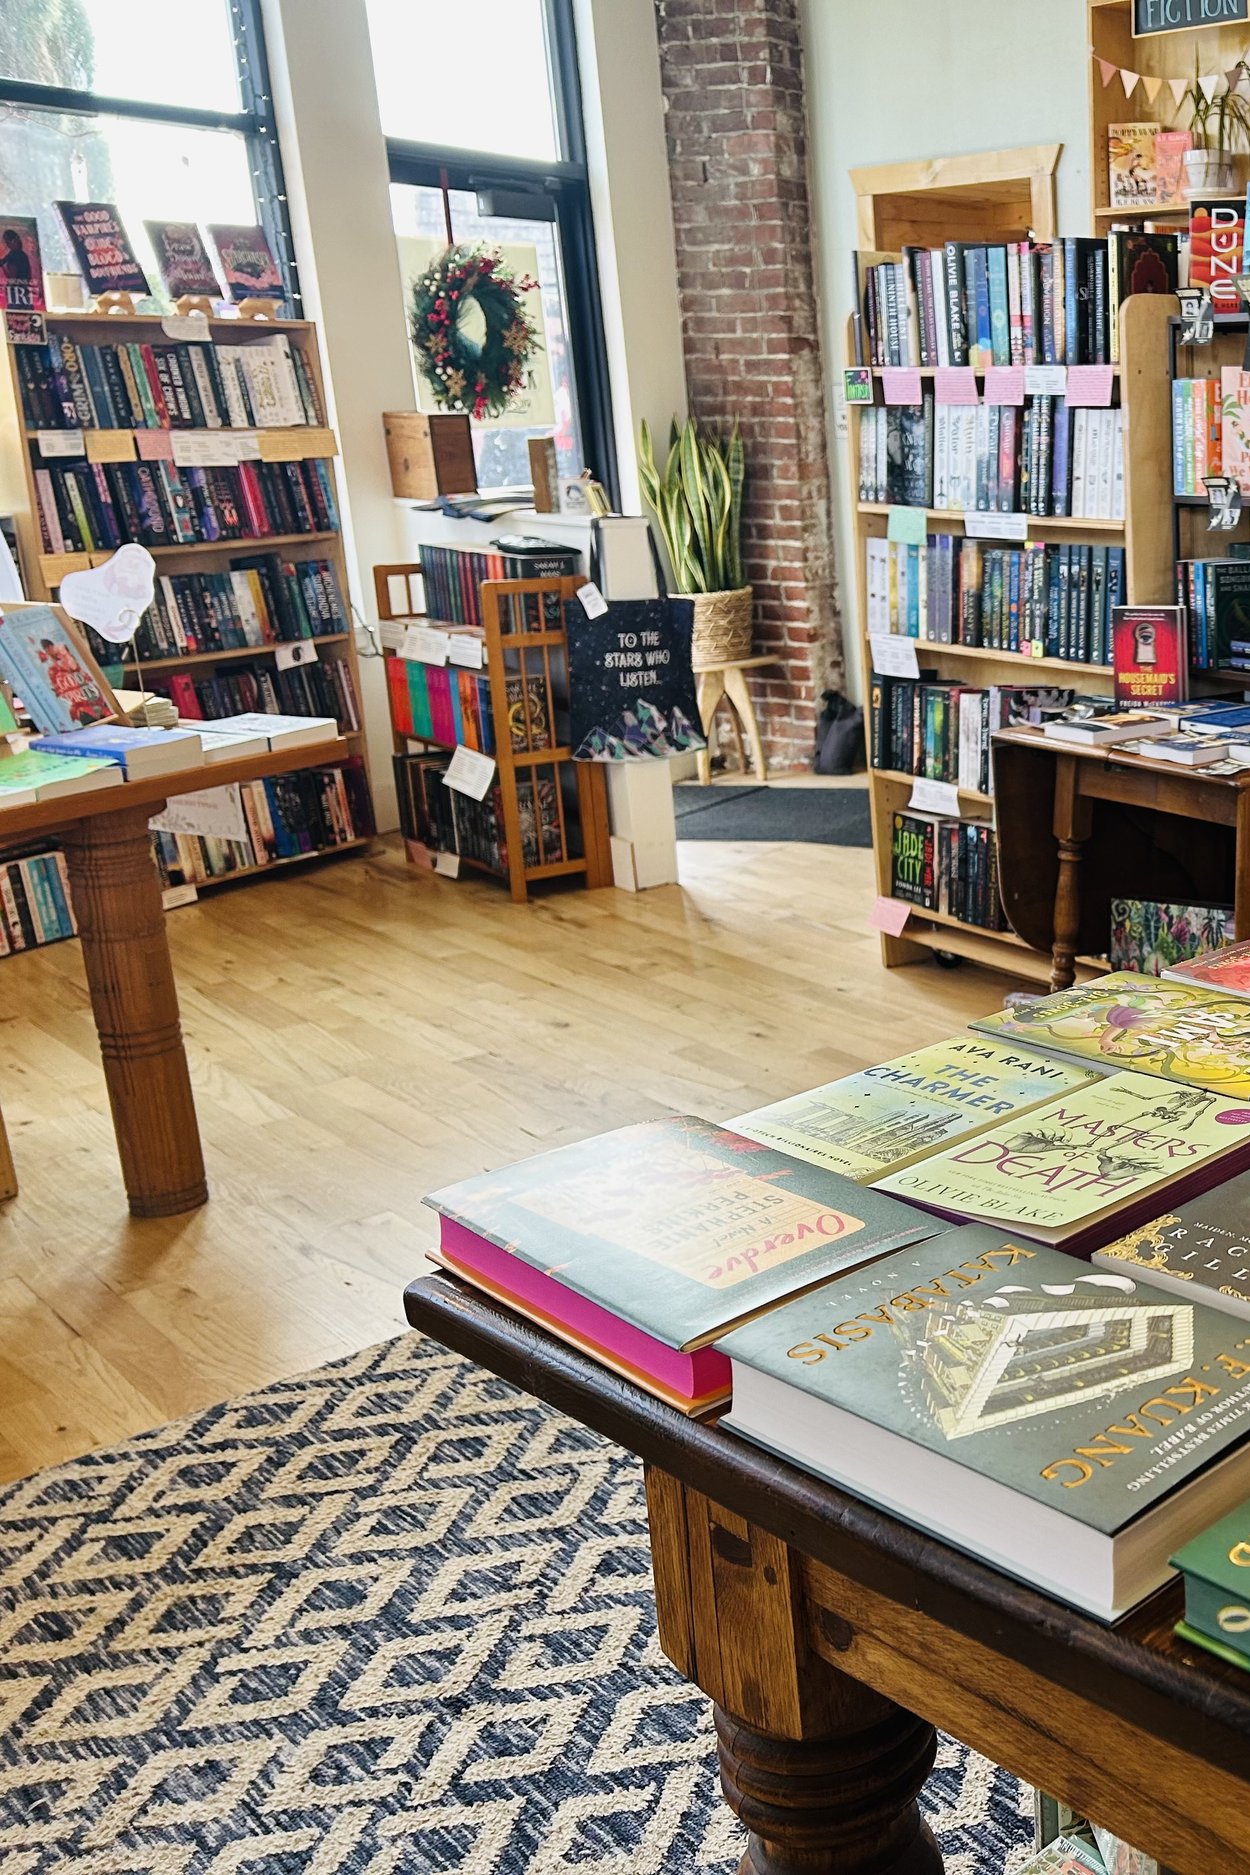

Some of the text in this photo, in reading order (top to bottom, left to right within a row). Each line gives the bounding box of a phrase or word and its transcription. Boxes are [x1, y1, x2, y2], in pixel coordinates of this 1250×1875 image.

[1211, 208, 1239, 300] DUNE
[946, 246, 960, 329] OLIVIE BLAKE
[617, 631, 660, 649] TO THE
[604, 649, 671, 668] STARS WHO
[1118, 672, 1175, 685] HOUSEMAID'S
[1130, 685, 1163, 696] SECRET
[894, 831, 924, 861] JADE
[897, 855, 922, 885] CITY
[934, 1064, 1000, 1088] THE
[947, 1043, 1066, 1079] AVA RANI
[862, 1066, 1014, 1115] CHARMER
[1041, 1108, 1211, 1160] MASTERS
[828, 1154, 853, 1167] NOVEL
[950, 1140, 1140, 1198] DEATH
[1063, 1149, 1095, 1162] OF
[643, 1189, 749, 1238] PERKINS
[898, 1176, 977, 1207] OLIVIE
[976, 1197, 1065, 1222] BLAKE
[649, 1193, 786, 1256] STEPHANIE
[711, 1223, 756, 1247] Novel
[1193, 1222, 1237, 1239] MAIDEN.
[701, 1212, 846, 1288] Overdue
[785, 1242, 1037, 1367] KATABASIS
[824, 1271, 899, 1309] NOVEL
[1038, 1375, 1221, 1490] KUANG
[1195, 1411, 1213, 1426] OF
[1207, 1408, 1244, 1435] TIMES
[1149, 1423, 1197, 1455] BABEL
[1128, 1432, 1210, 1491] BESTSELLING
